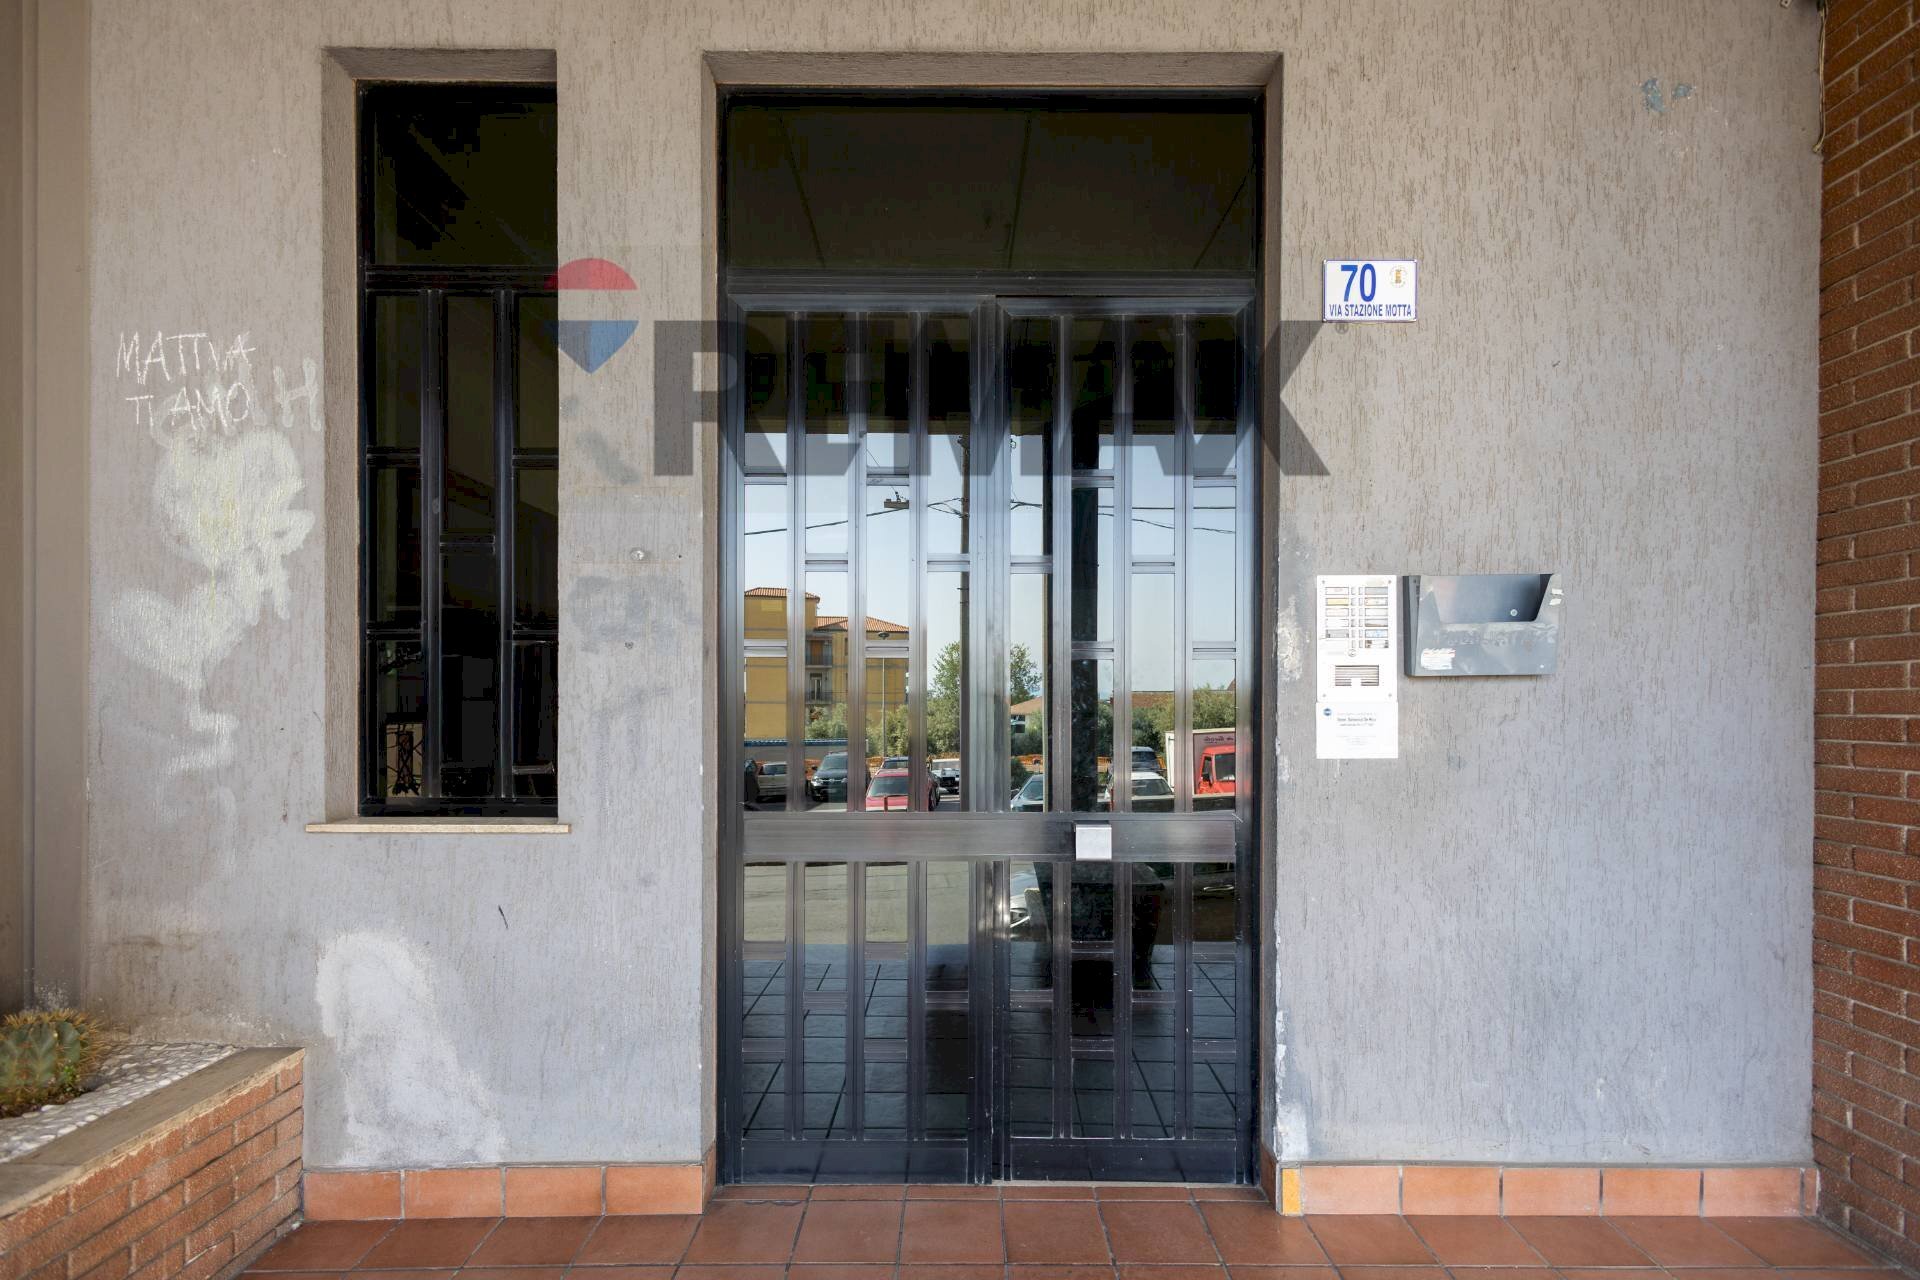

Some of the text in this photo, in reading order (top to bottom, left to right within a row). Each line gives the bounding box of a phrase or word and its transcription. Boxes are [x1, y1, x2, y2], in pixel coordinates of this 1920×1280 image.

[1340, 263, 1377, 302] 70
[1329, 304, 1412, 317] VIA STAZIONE MOTTA
